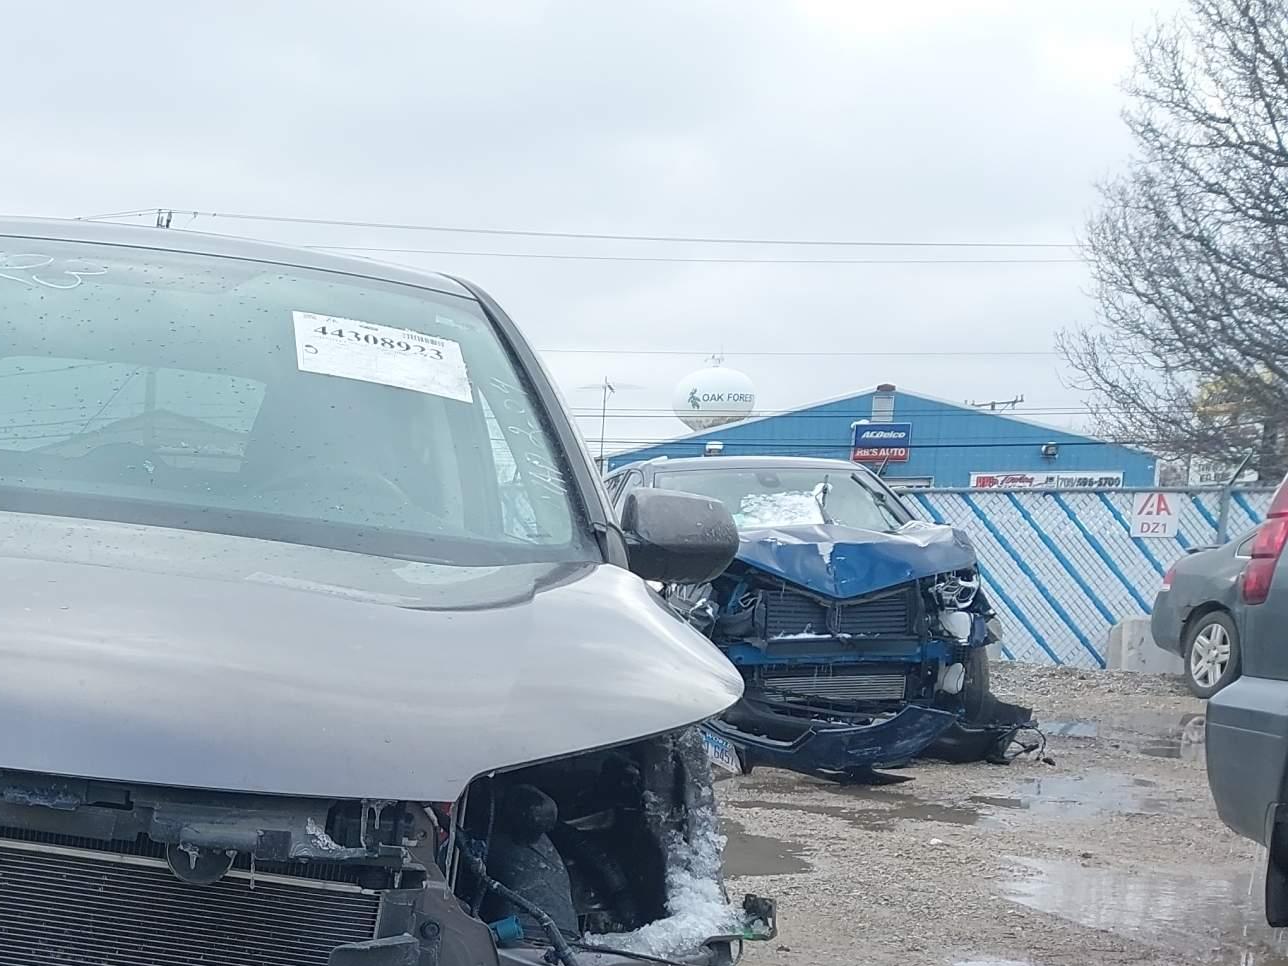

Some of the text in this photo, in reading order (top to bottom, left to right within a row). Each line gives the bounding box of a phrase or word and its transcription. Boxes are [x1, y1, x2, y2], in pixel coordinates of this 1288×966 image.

[314, 325, 444, 361] 44308923
[701, 393, 724, 402] OAK
[878, 447, 906, 457] AUTO
[1140, 522, 1168, 534] DZ1
